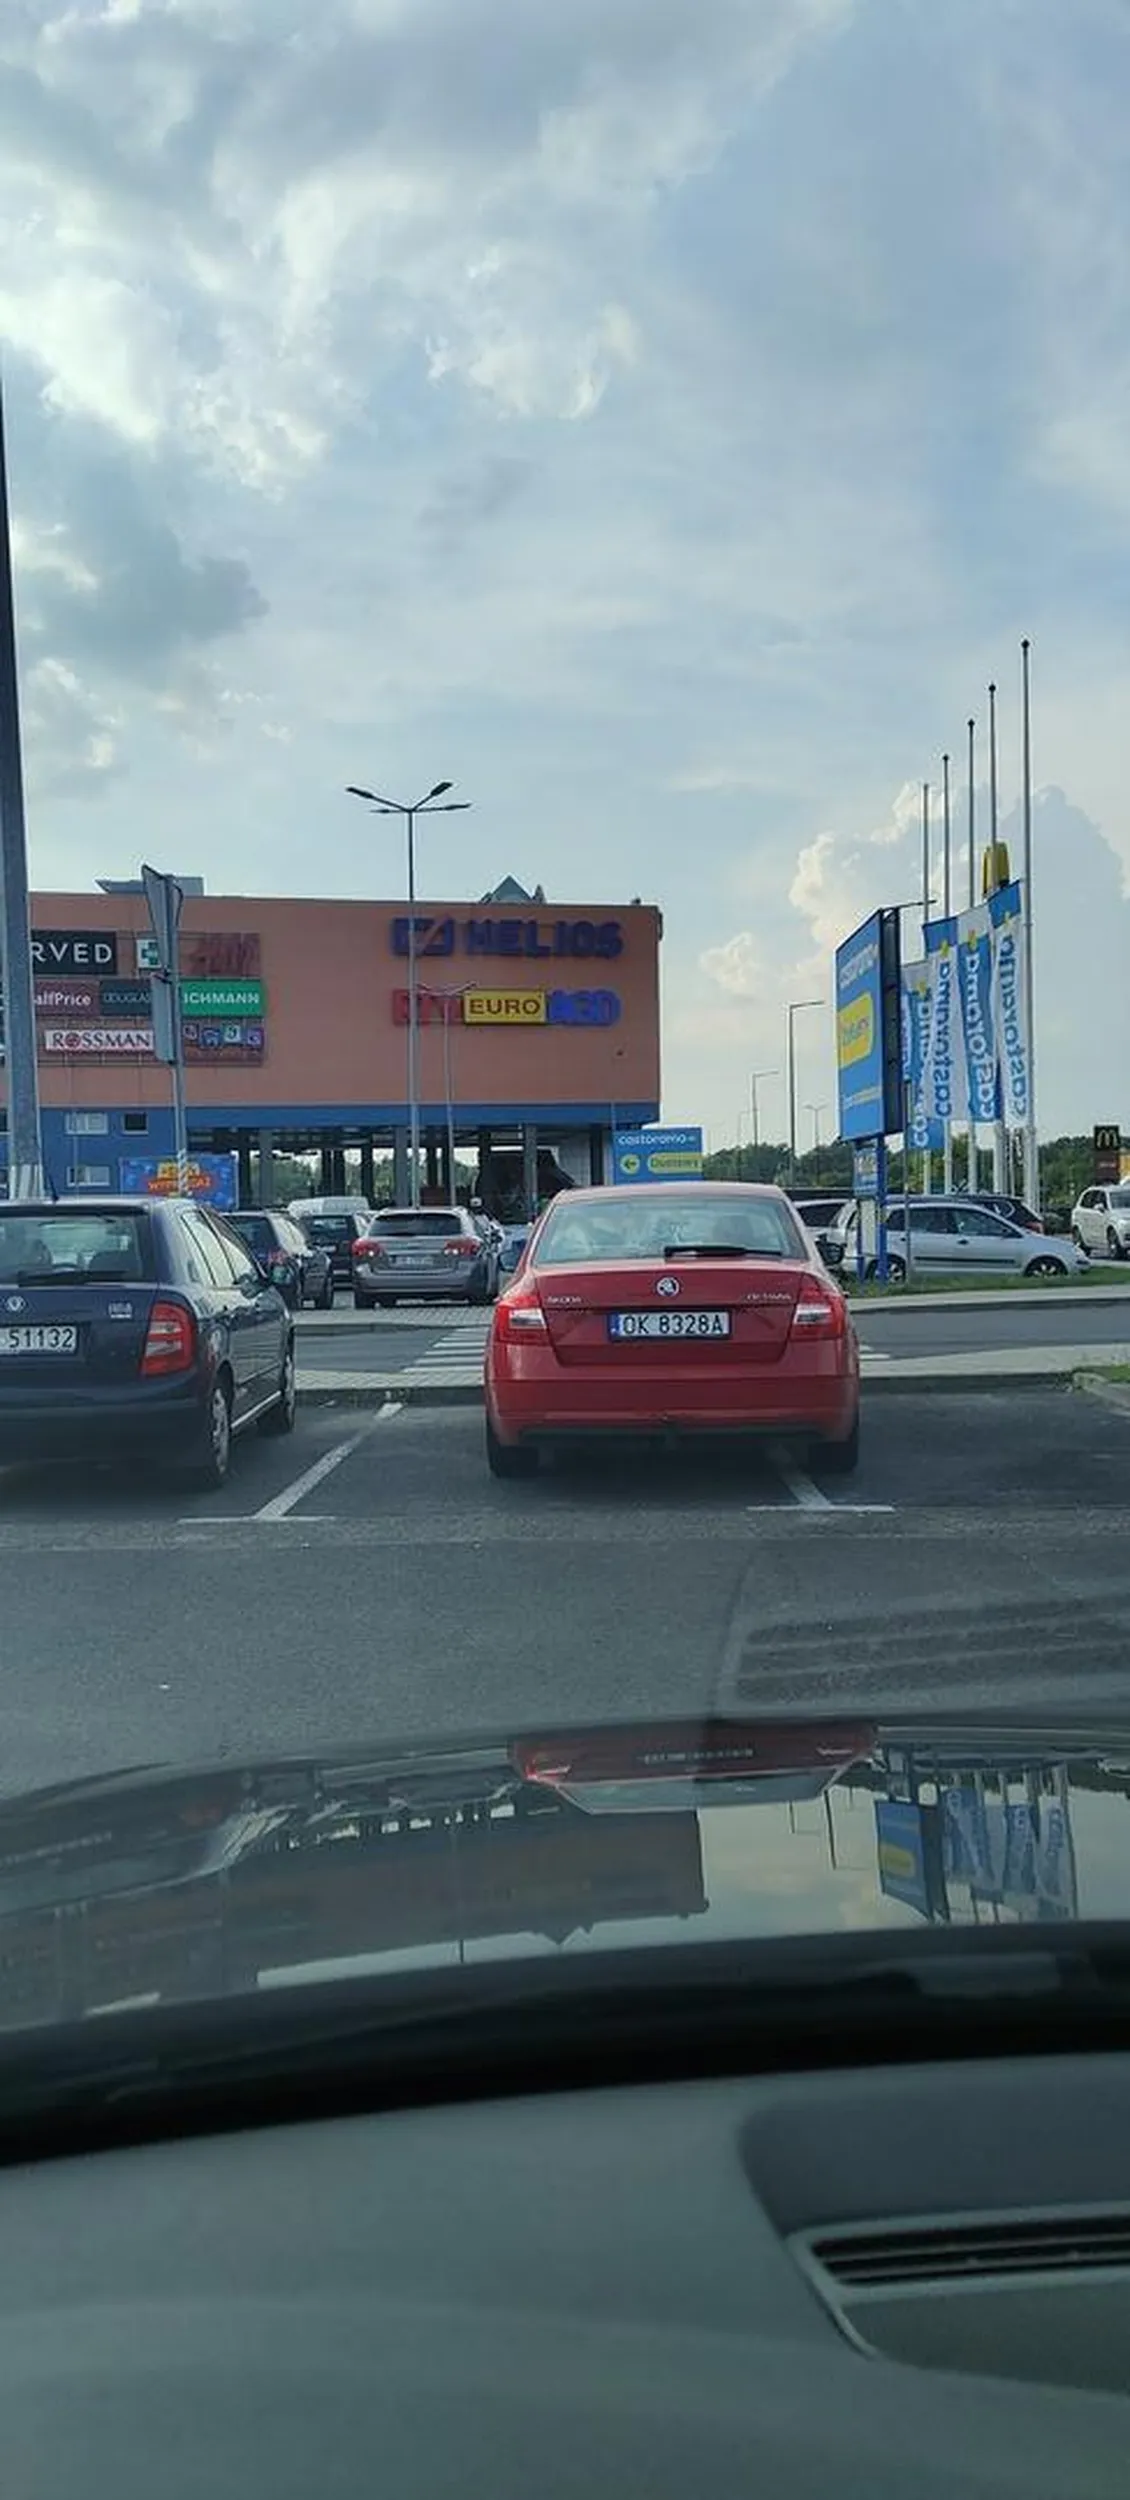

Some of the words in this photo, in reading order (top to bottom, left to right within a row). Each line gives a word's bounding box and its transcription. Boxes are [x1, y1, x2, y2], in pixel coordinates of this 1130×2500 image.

[466, 916, 623, 958] HELIOS
[31, 941, 113, 964] RVED
[34, 991, 91, 1006] alfPrice
[184, 992, 261, 1004] ICHMANN
[469, 999, 541, 1015] EURO
[52, 1032, 150, 1048] ROSSMAN
[623, 1315, 649, 1335] OK
[659, 1314, 723, 1335] 8328A
[8, 1328, 73, 1349] 51132
